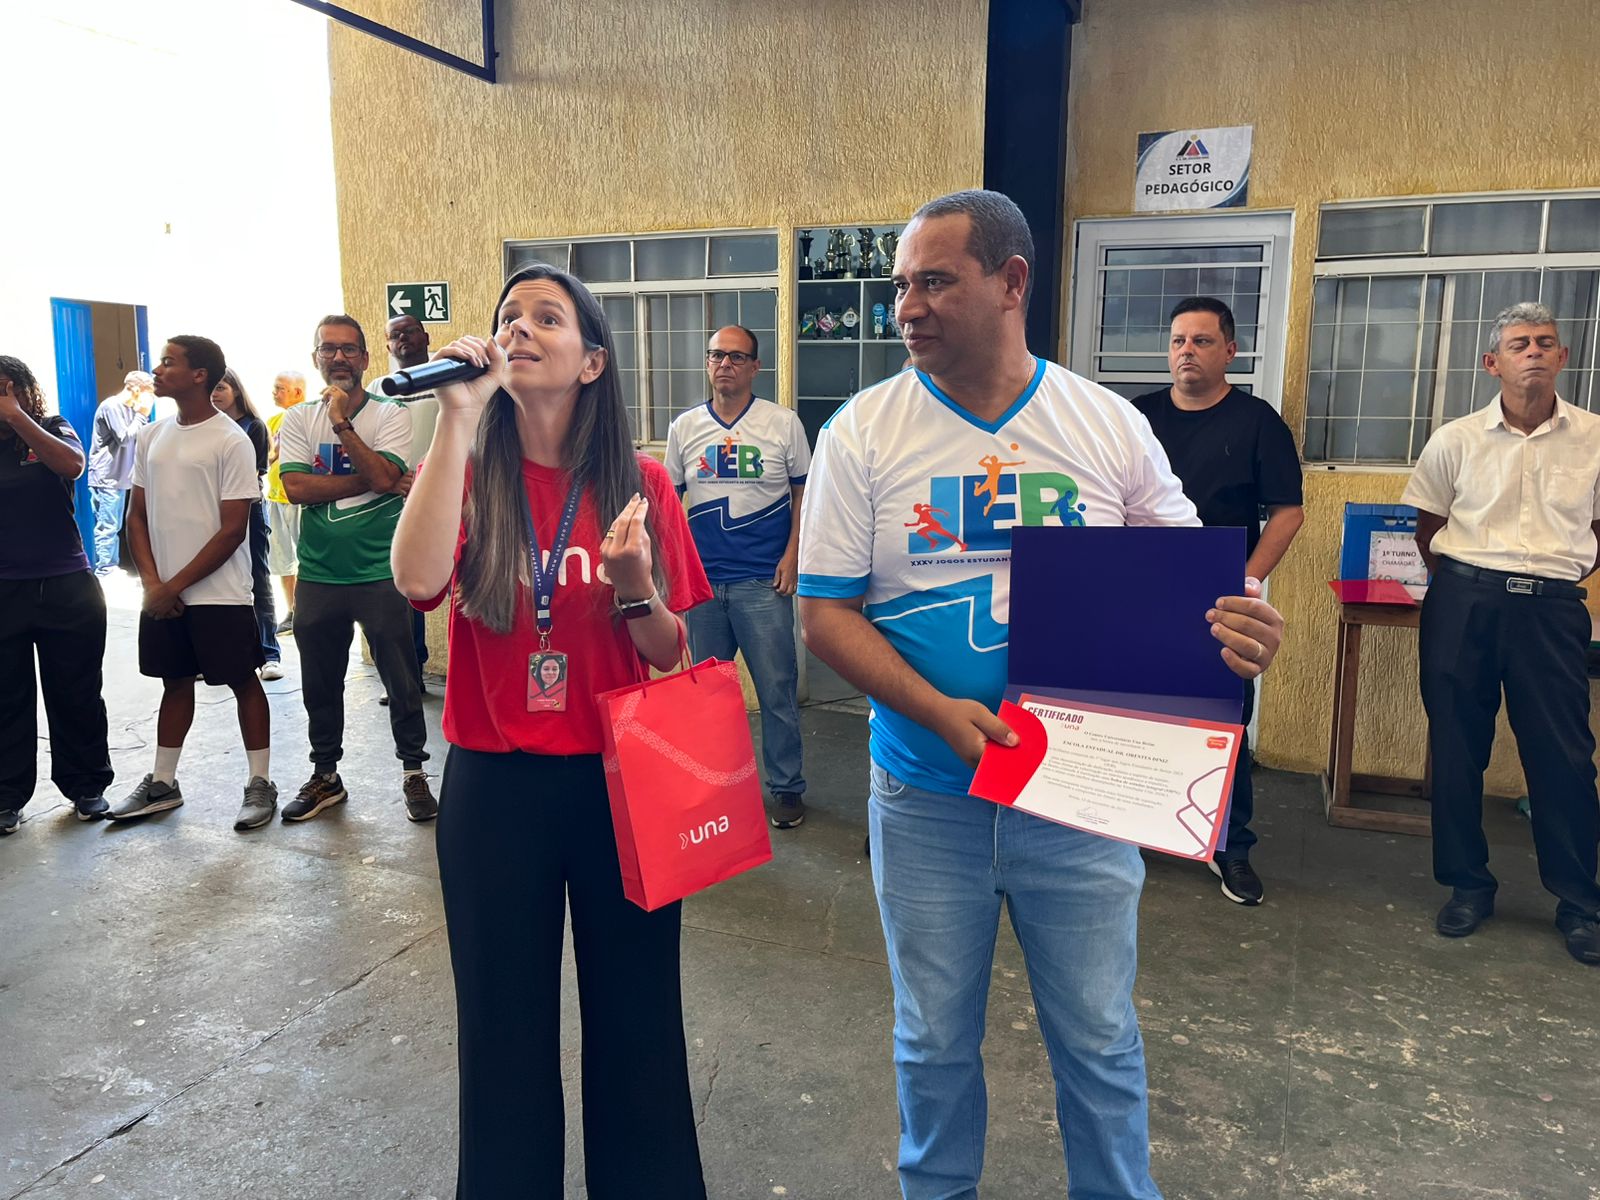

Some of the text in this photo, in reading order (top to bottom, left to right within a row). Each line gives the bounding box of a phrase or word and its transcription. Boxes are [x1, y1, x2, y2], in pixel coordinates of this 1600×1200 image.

[1169, 162, 1212, 176] SETOR
[1145, 179, 1234, 195] PEDAGÓGICO
[910, 559, 933, 567] XXXV
[1028, 706, 1084, 724] CERTIFICADO
[689, 815, 730, 845] una
